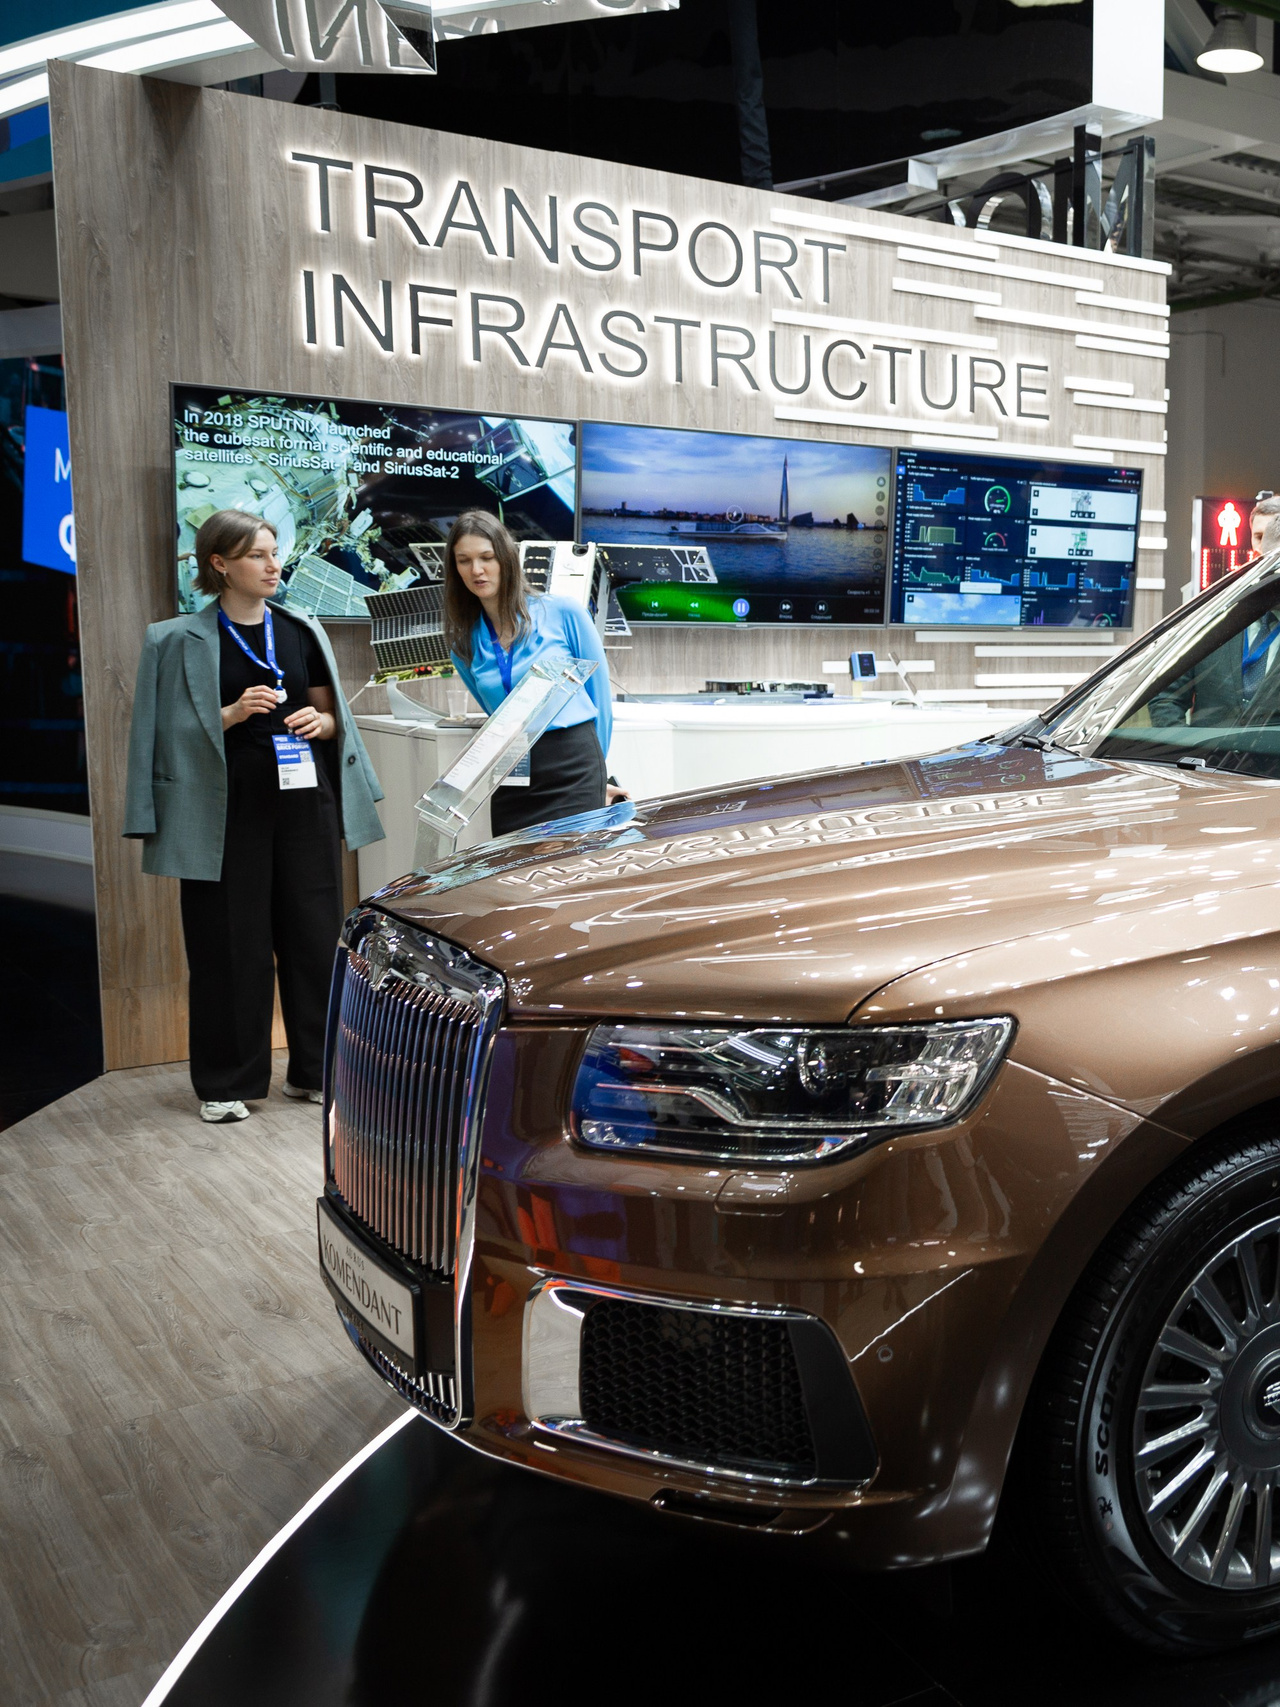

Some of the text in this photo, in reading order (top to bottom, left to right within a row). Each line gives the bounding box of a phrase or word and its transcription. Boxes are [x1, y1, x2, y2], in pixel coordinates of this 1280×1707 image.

[291, 151, 847, 304] TRANSPORT
[303, 269, 1051, 422] INFRASTRUCTURE
[184, 409, 391, 440] In 2018 SPUTNIX launched
[184, 428, 504, 465] the cubesat format scientific and educational
[184, 449, 253, 465] satellites
[268, 452, 348, 471] SiriusSat-1
[353, 461, 380, 474] and
[384, 464, 460, 479] SiriusSat-2
[323, 1234, 402, 1335] KOMENDANT
